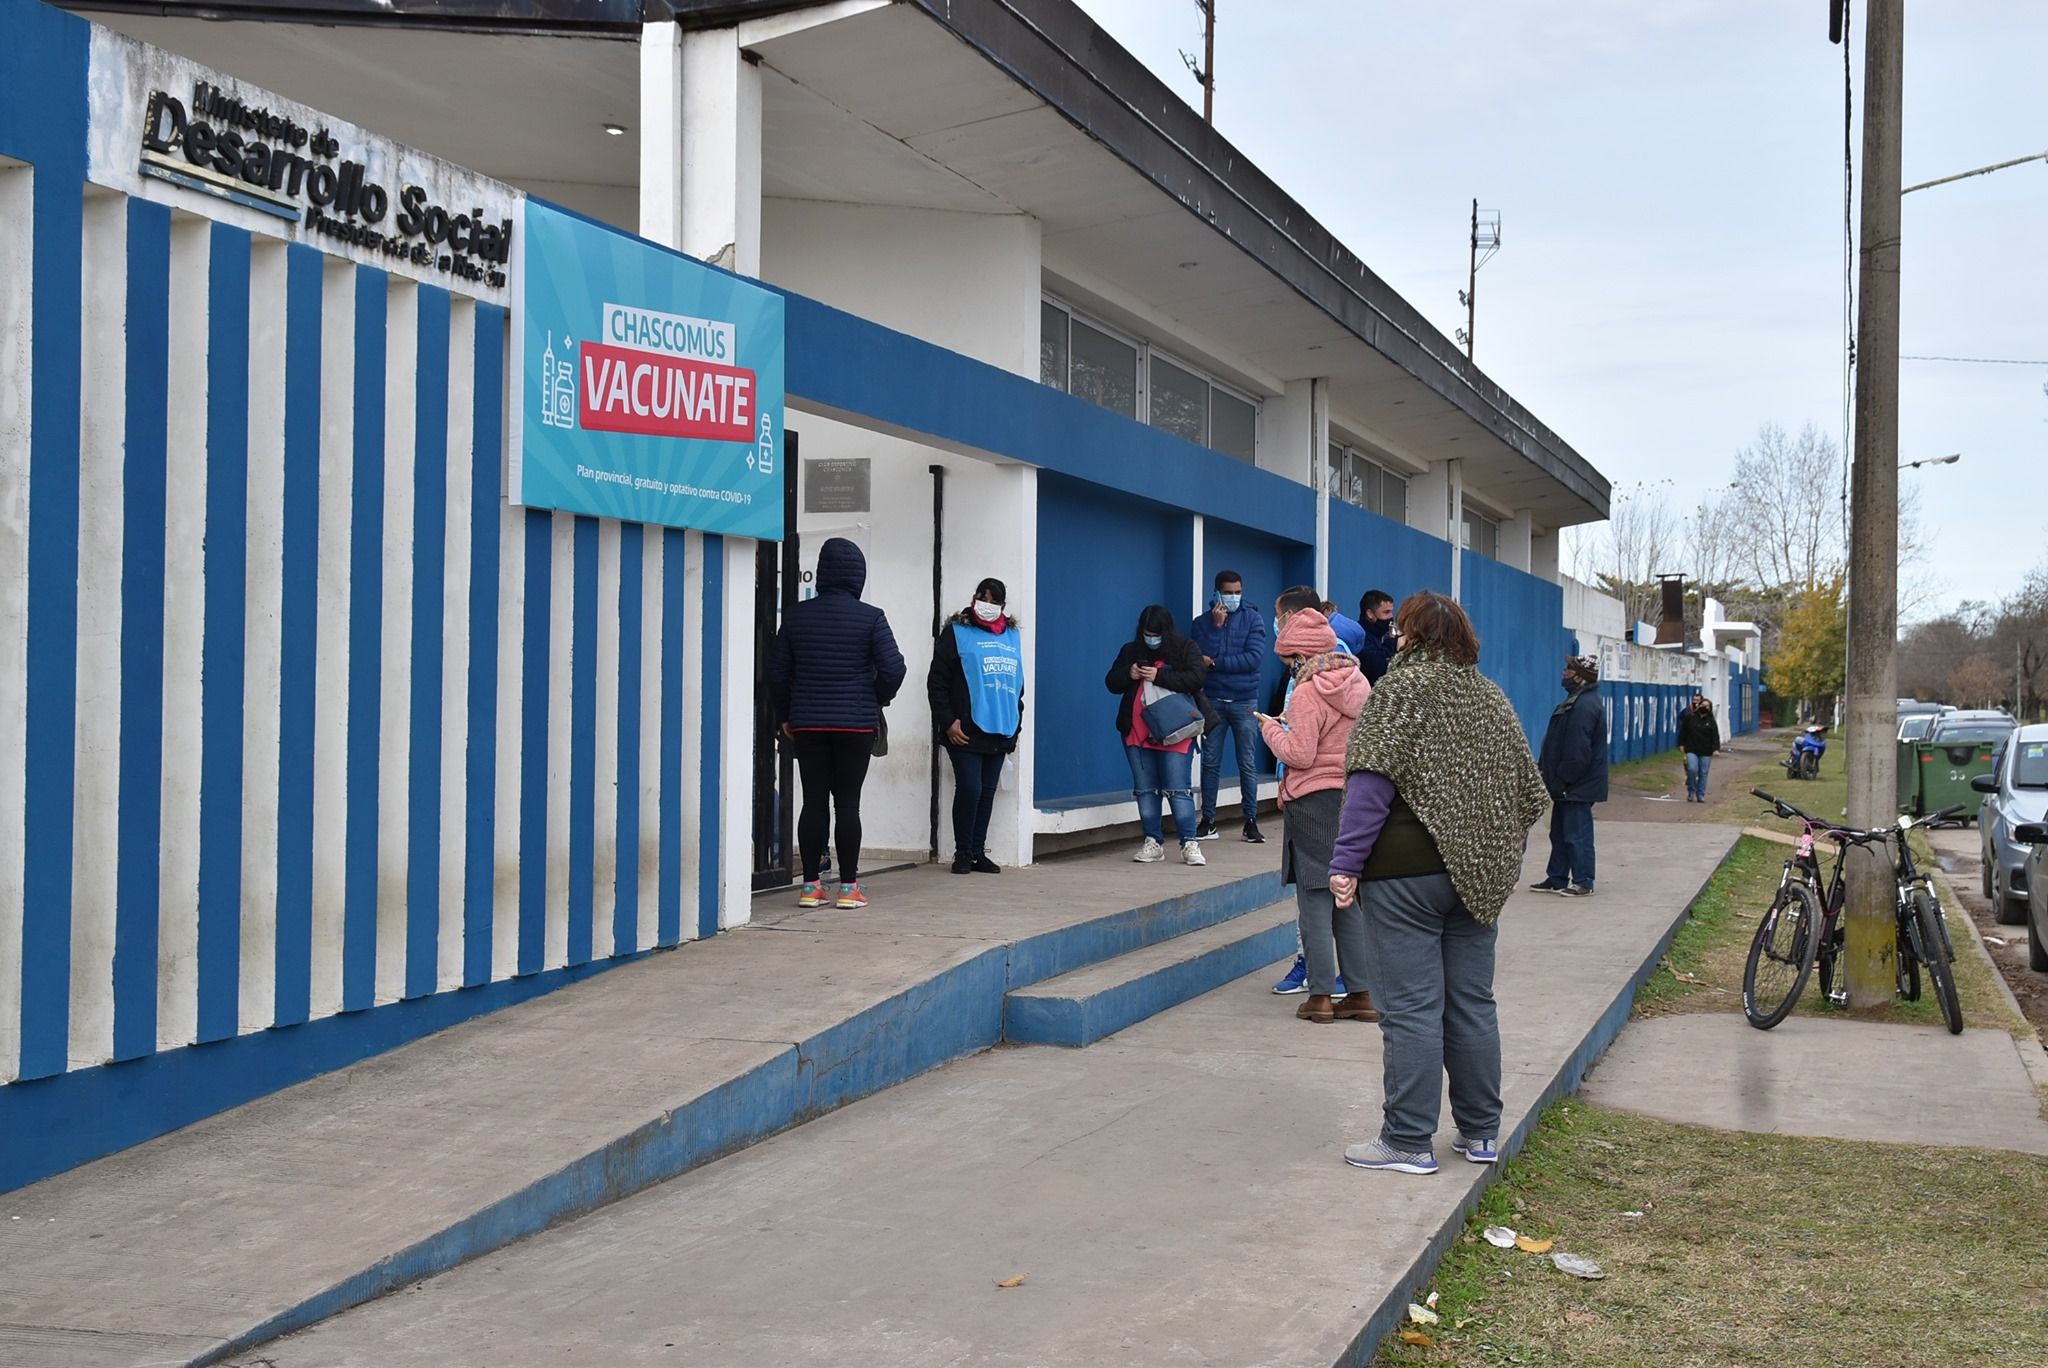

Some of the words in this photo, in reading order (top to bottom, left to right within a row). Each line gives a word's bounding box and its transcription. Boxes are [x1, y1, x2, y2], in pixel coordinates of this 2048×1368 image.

[193, 80, 308, 148] Ministerio
[310, 124, 340, 159] de
[143, 89, 388, 223] Desarrollo
[397, 183, 513, 264] Social
[305, 206, 409, 258] Presidencia
[610, 309, 726, 359] CHASCOMÚS
[584, 355, 751, 426] VACUNATE
[576, 464, 594, 479] Plan
[595, 470, 633, 487] provincial,
[634, 477, 663, 490] gratuito
[663, 483, 669, 494] y
[669, 483, 698, 496] optativo
[698, 488, 720, 500] contra
[720, 490, 752, 504] COVID-19
